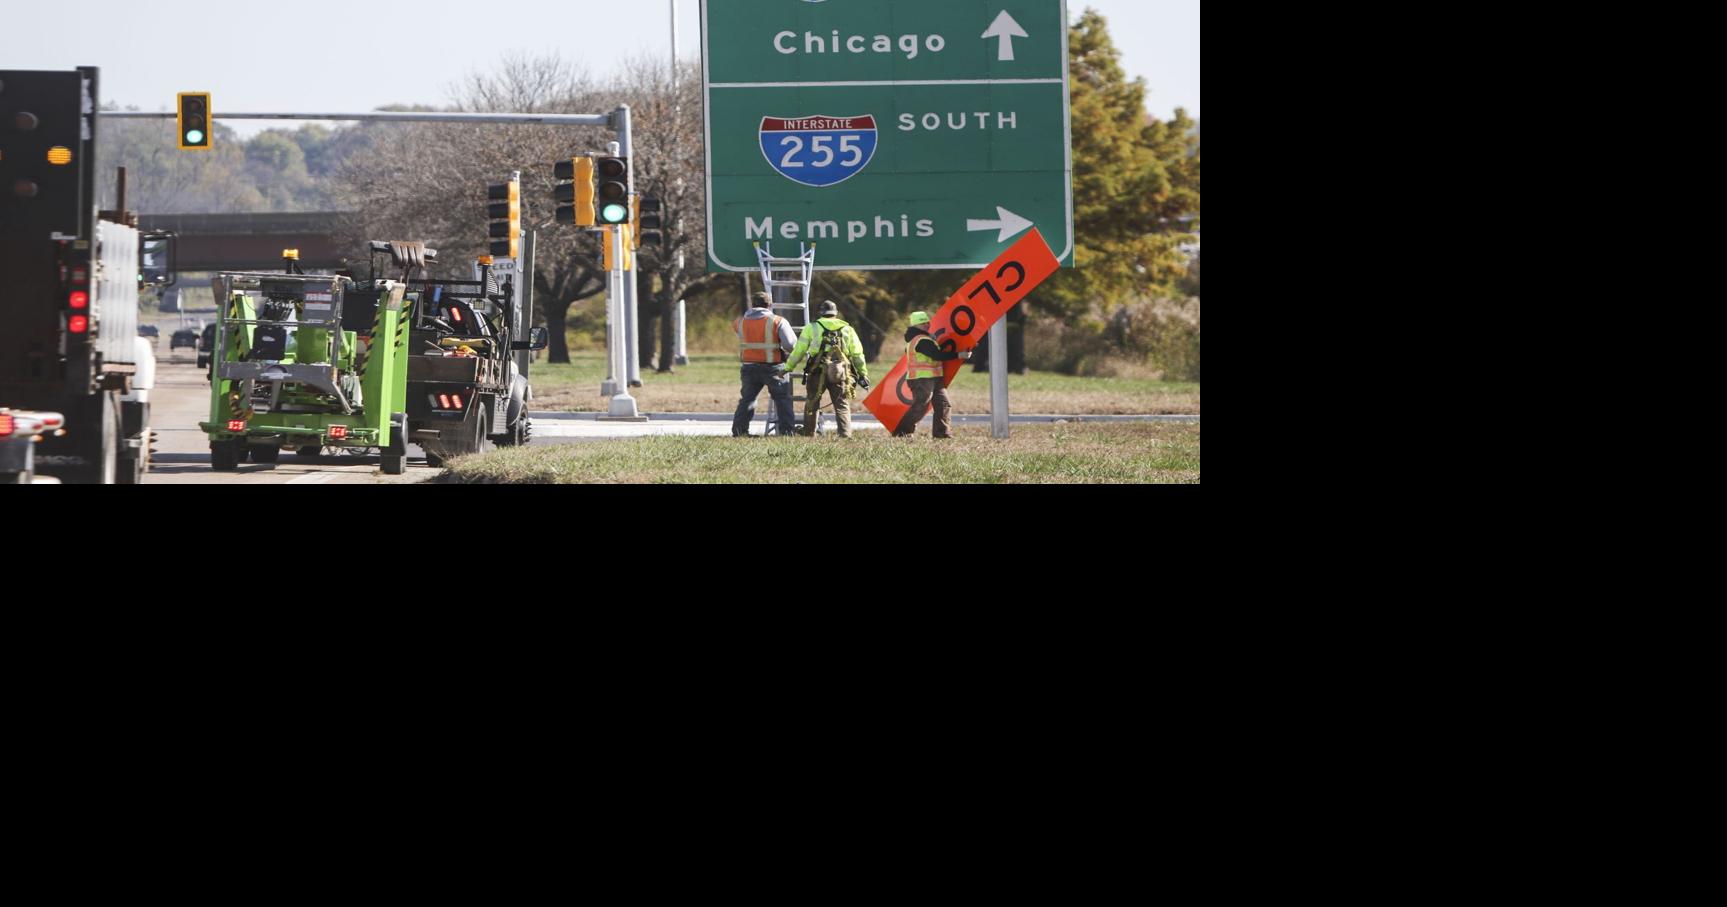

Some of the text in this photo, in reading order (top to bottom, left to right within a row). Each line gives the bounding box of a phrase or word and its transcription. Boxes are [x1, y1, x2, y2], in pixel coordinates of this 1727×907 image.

[773, 30, 946, 59] Chicago
[783, 119, 853, 130] INTERSTATE
[898, 112, 1017, 131] SOUTH
[780, 135, 863, 168] 255
[745, 214, 934, 242] Memphis
